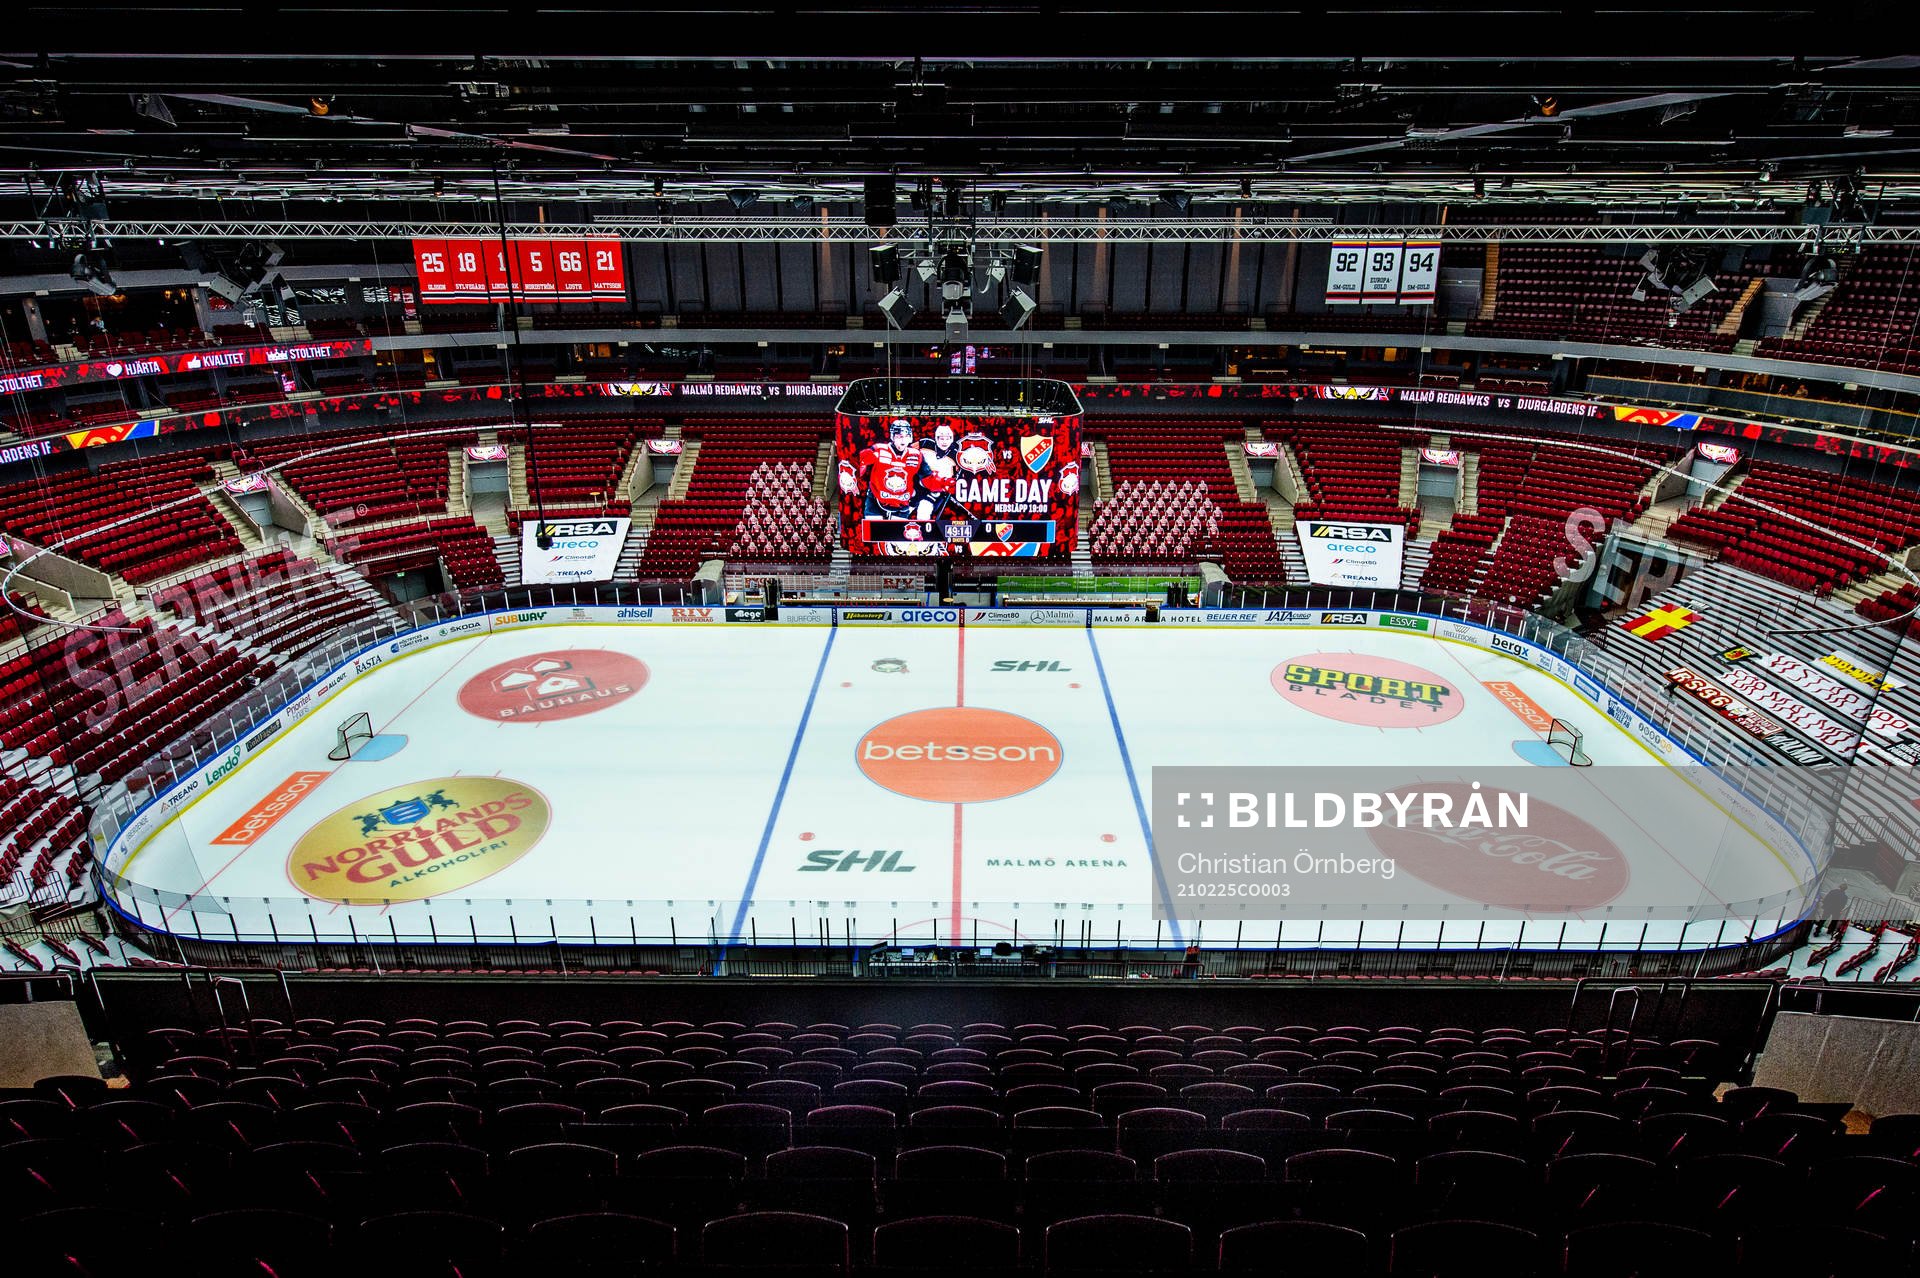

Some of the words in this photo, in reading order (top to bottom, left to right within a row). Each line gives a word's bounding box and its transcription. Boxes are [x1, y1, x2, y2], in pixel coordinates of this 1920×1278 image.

[422, 252, 445, 272] 25
[457, 252, 477, 272] 18
[530, 251, 543, 272] 5
[560, 251, 582, 272] 66
[596, 250, 615, 271] 21
[1336, 253, 1358, 272] 92
[1372, 252, 1395, 272] 93
[1409, 252, 1434, 272] 94
[203, 352, 244, 367] KVALITET
[289, 346, 331, 360] STOLTHET
[125, 360, 161, 375] HJÄRTA
[681, 383, 713, 396] MALMÖ
[715, 384, 762, 396] REDHAWKS
[785, 383, 844, 396] DJURGÅRDENS
[1400, 390, 1435, 402] MALMÖ
[1436, 393, 1490, 407] REDHAWKS
[1517, 398, 1585, 415] DJURGÅRDENS
[1587, 406, 1598, 417] IF
[1038, 416, 1054, 424] SHL
[40, 440, 51, 456] IF
[1002, 450, 1013, 460] VS
[955, 478, 1010, 503] GAME
[1015, 478, 1053, 503] DAY
[554, 522, 614, 536] RSA
[925, 522, 932, 533] 0
[946, 526, 970, 537] 49:14
[985, 523, 992, 533] 0
[1328, 526, 1390, 541] RSA
[550, 541, 599, 549] areco
[954, 545, 963, 554] VS
[1327, 543, 1377, 553] areco
[494, 611, 548, 626] SUBWAY
[617, 608, 653, 618] ahlsell
[671, 608, 712, 617] RIV
[786, 615, 822, 623] BJURFORS
[901, 610, 957, 622] areco
[988, 611, 1020, 619] Climat80
[1046, 610, 1075, 619] Malmö
[1094, 613, 1130, 623] MALMÖ
[1265, 611, 1293, 621] JATA
[1330, 613, 1366, 624] RSA
[1389, 616, 1418, 628] ESSVE
[1443, 629, 1478, 644] TRELLEBORG
[1492, 633, 1530, 656] bergx
[355, 654, 382, 675] RASTA
[990, 660, 1073, 672] SHL
[328, 679, 338, 689] ALL
[1284, 663, 1450, 706] SPORT
[285, 693, 312, 717] Prioritet
[500, 683, 633, 719] BAUHAUS
[1289, 684, 1443, 712] BLADET
[1491, 682, 1553, 731] betsson
[863, 741, 1055, 762] betsson
[205, 755, 239, 787] Lendo
[167, 780, 199, 807] TREANO
[222, 772, 322, 843] betsson
[302, 791, 534, 881] NORRLANDS
[1381, 804, 1615, 882] Coca-Cola
[345, 812, 523, 885] GULD
[390, 840, 509, 888] ALKOHOLFRI
[797, 850, 917, 873] SHL
[986, 856, 1056, 867] MALMÖ
[1065, 859, 1128, 868] ARENA
